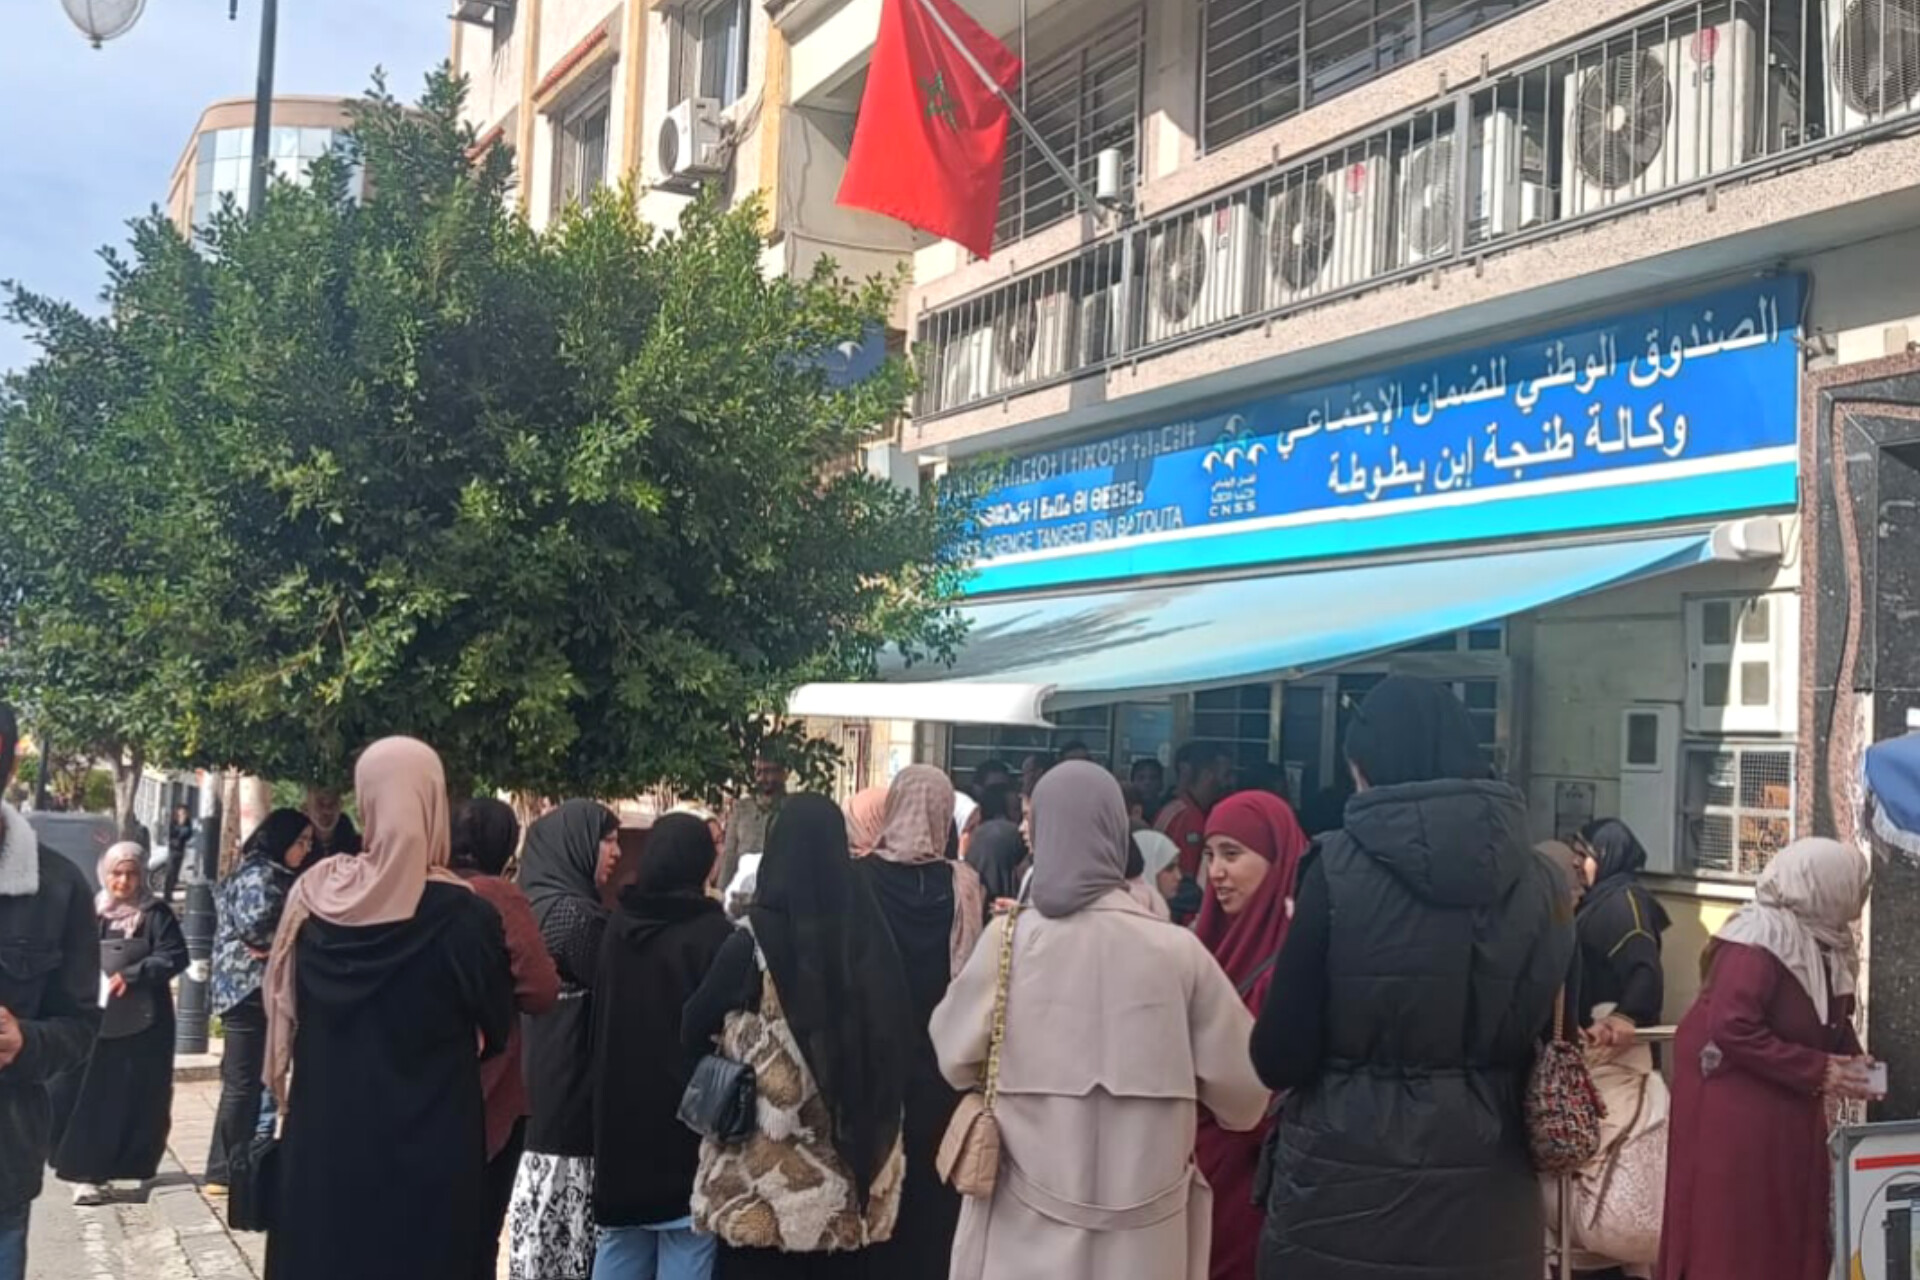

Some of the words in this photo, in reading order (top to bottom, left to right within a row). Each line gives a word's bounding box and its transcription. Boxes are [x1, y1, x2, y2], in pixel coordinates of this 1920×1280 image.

[1628, 296, 1780, 387] الصندوق
[1411, 355, 1508, 425] للضمان
[1514, 334, 1616, 415] الوطني
[1277, 383, 1404, 455] الإجتماعي
[1483, 416, 1575, 480] طنجة
[1584, 403, 1688, 457] وكالة
[1328, 444, 1427, 501] بطوطة
[1433, 437, 1474, 491] إبن
[983, 530, 1034, 558] AGENCE
[1037, 523, 1087, 550] TANGER
[1091, 518, 1114, 541] IBN
[1117, 505, 1184, 537] BATOUTA
[1209, 500, 1256, 517] CNSS
